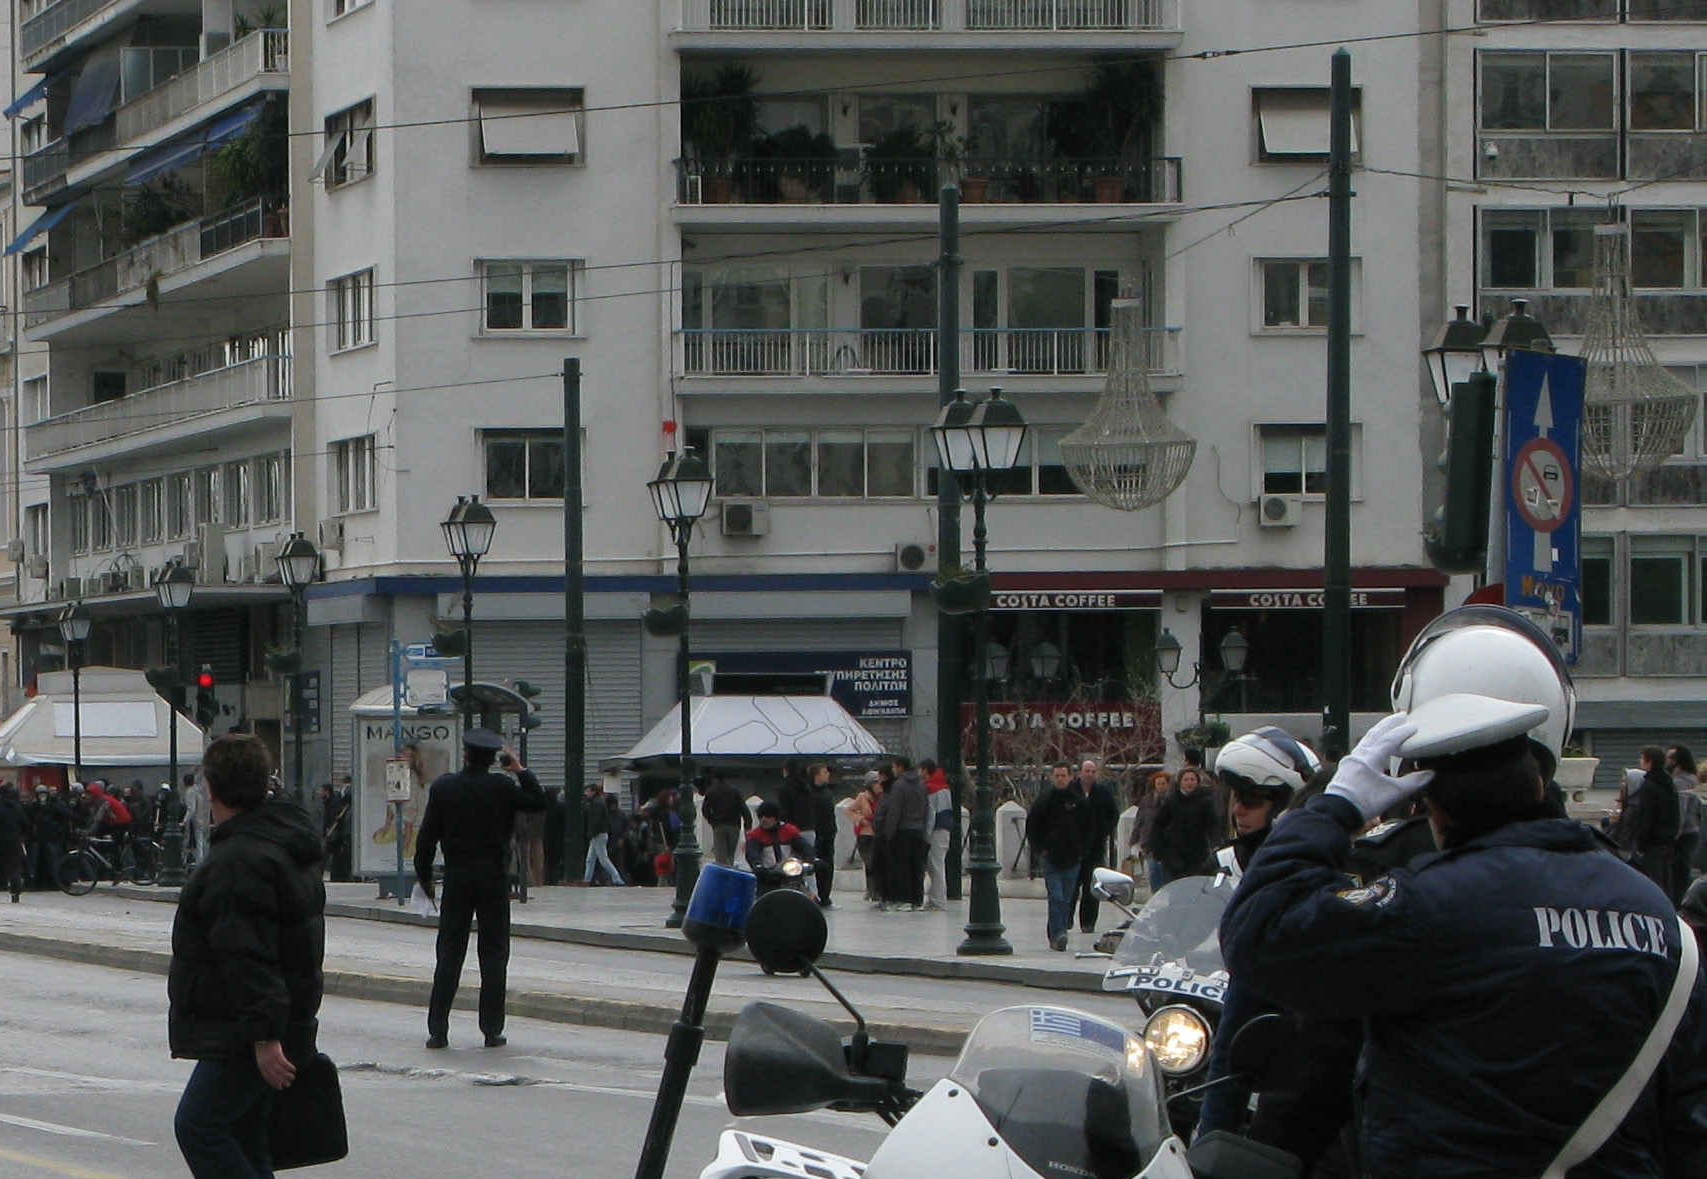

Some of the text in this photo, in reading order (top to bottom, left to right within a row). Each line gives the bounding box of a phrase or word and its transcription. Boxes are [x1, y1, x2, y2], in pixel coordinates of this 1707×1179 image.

[996, 594, 1116, 609] COSTA COFFEE
[1249, 593, 1368, 608] COSTA COEE
[859, 658, 907, 668] ΚΕΝΤΡΟ
[854, 681, 907, 691] ΠΟΛΙΤΩΝ
[989, 711, 1044, 731] OSTA
[366, 725, 450, 741] MANGO
[1533, 906, 1668, 959] POLICE
[1048, 1160, 1097, 1179] HONDA
